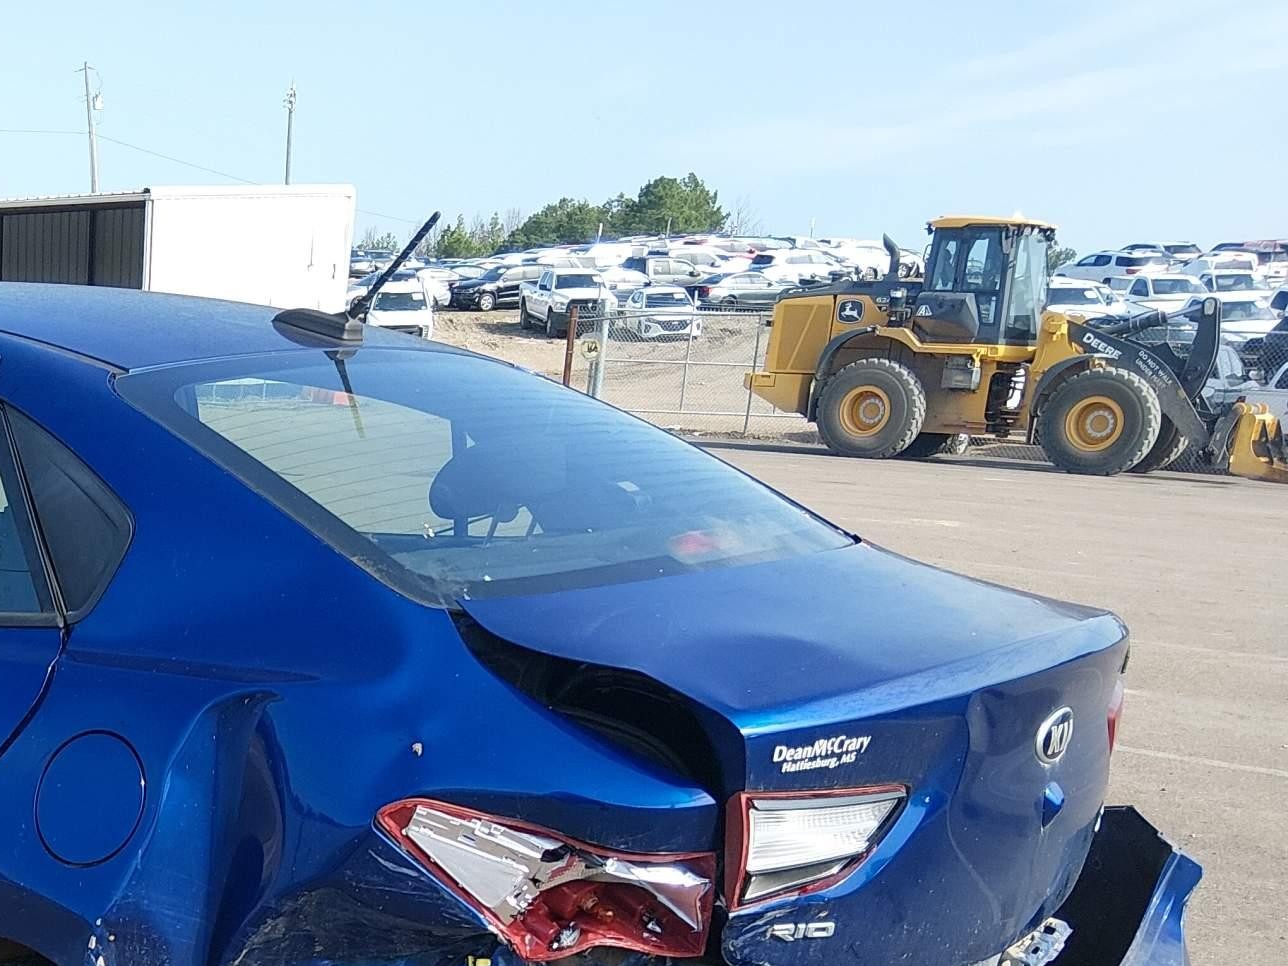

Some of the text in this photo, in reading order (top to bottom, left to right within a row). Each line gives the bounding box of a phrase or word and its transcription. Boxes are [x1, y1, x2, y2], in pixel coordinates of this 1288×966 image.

[1082, 333, 1122, 360] DEERE
[1139, 350, 1148, 360] DO
[1147, 359, 1160, 371] NOT
[781, 752, 857, 774] Hattiesburg, MS
[772, 922, 835, 942] RIO
